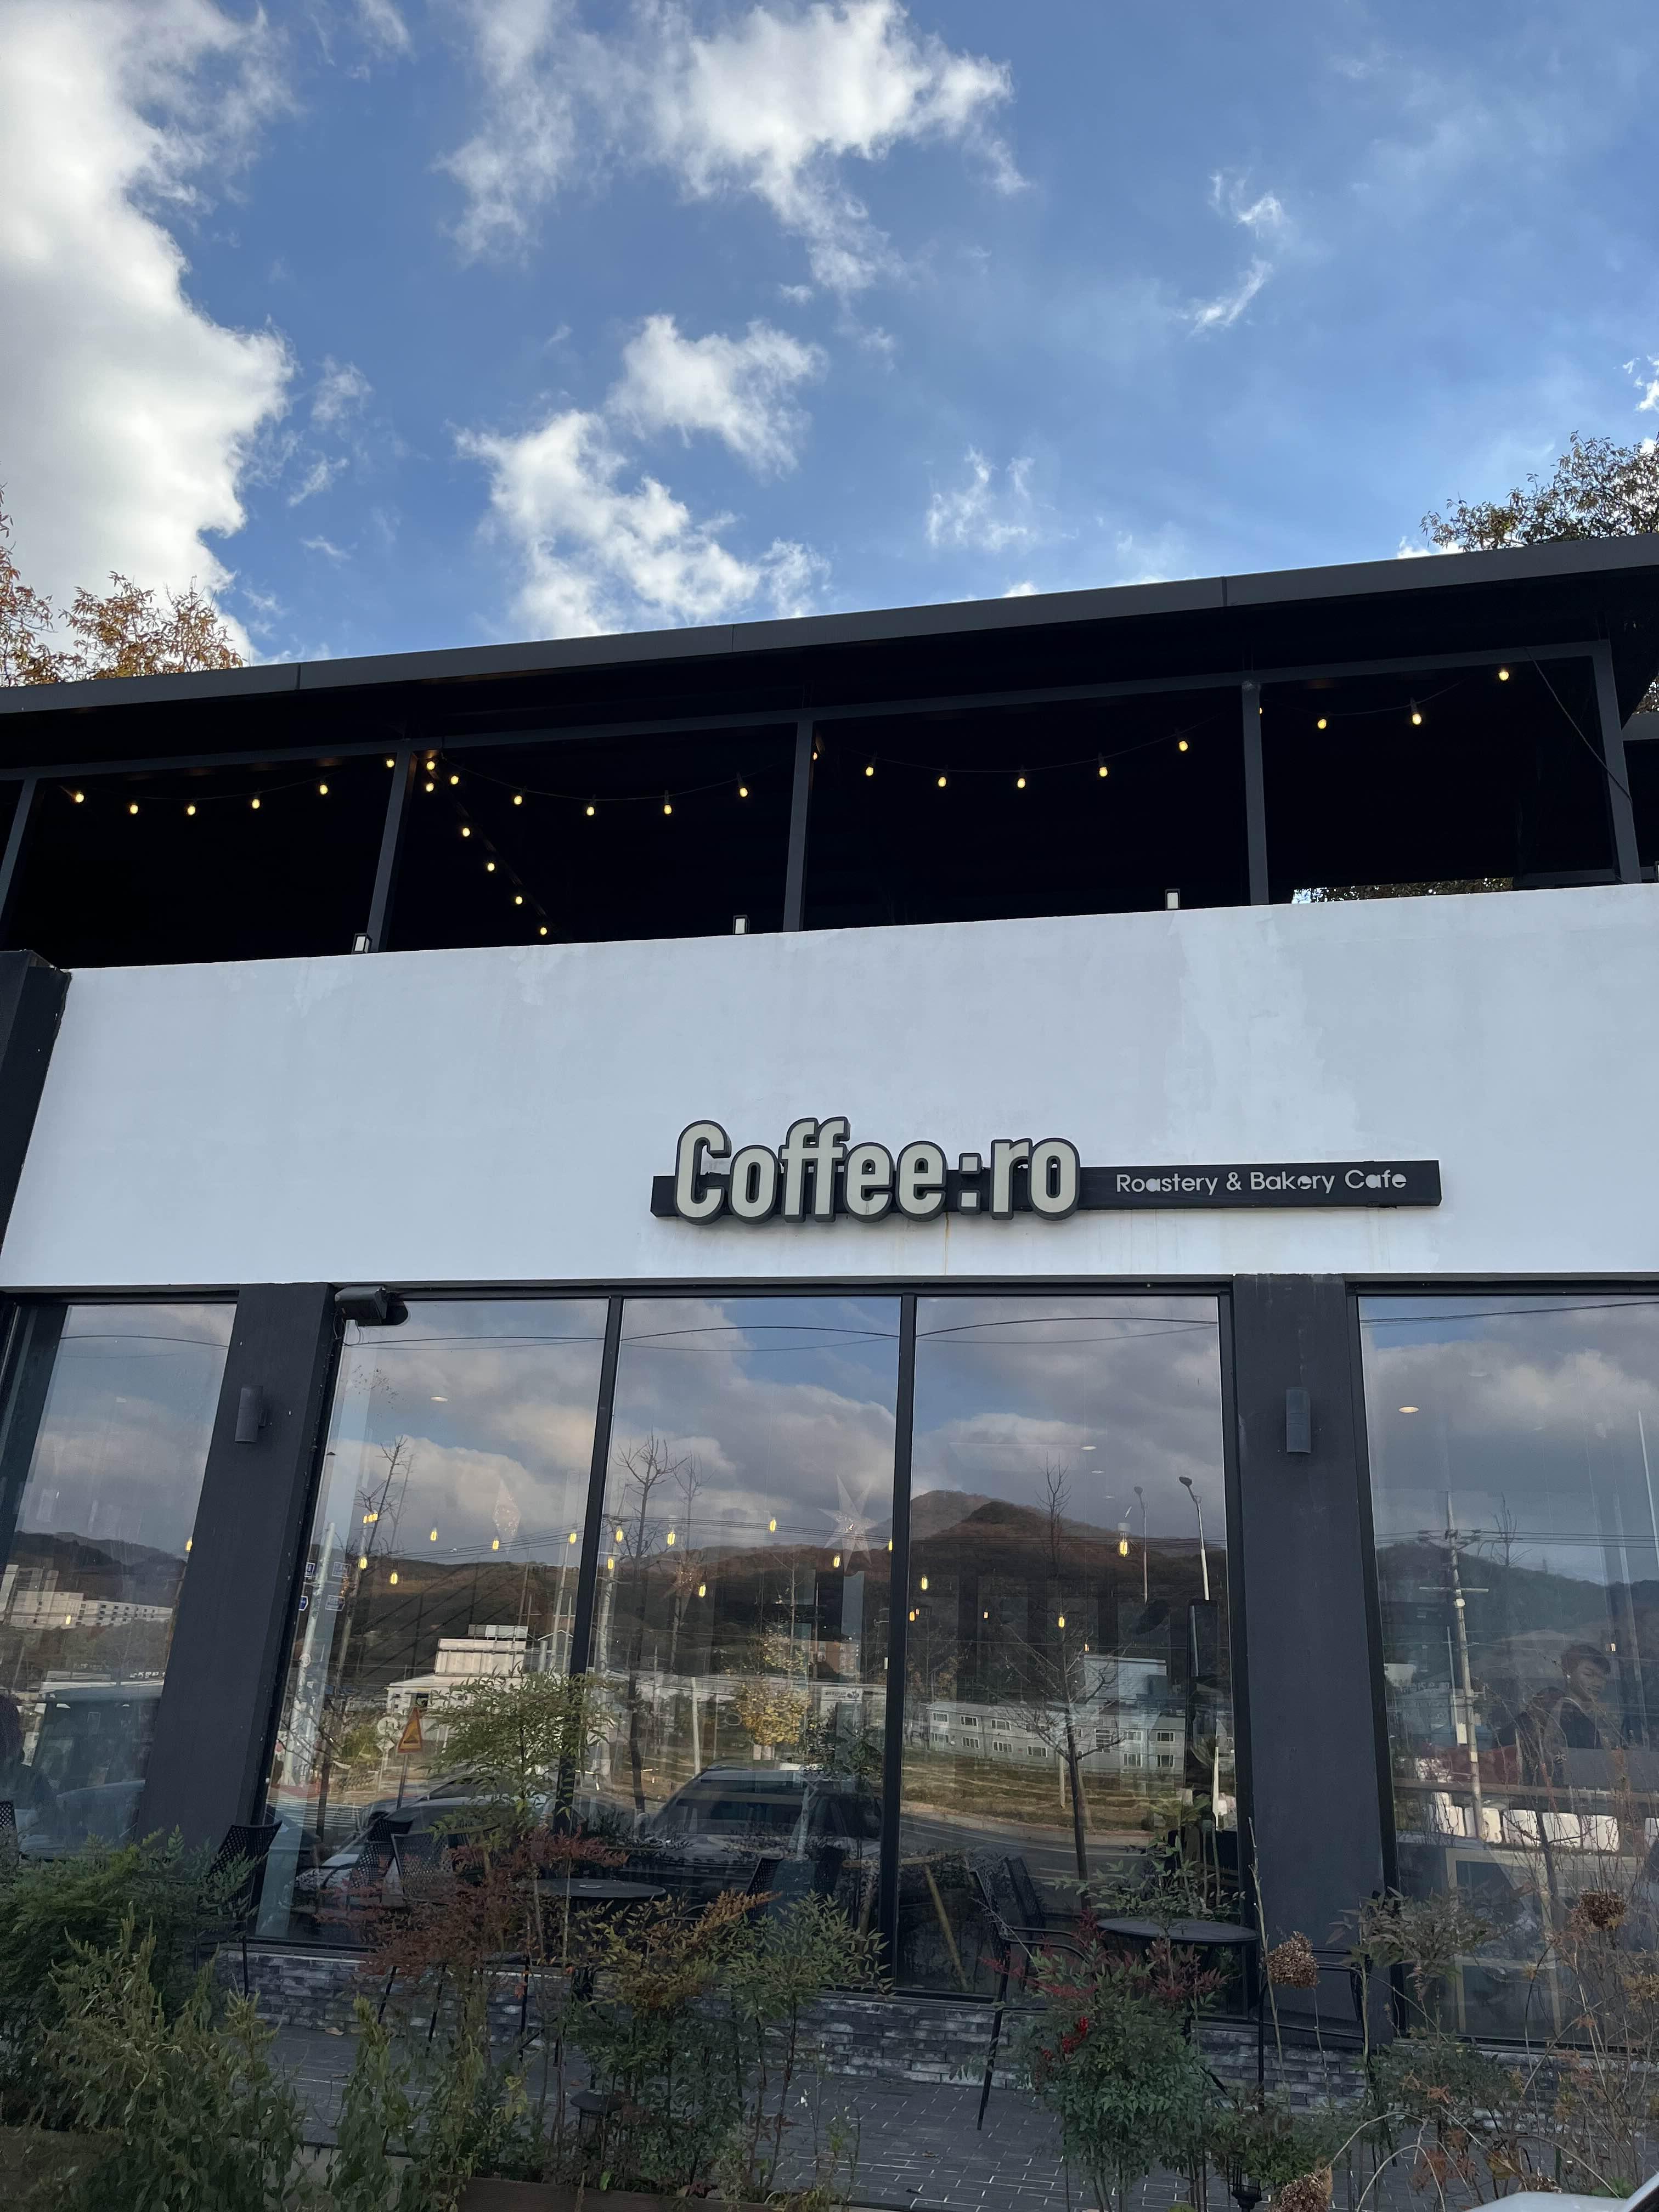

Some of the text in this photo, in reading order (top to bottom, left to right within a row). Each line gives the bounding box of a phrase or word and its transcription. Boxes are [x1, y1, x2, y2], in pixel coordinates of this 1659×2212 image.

[1116, 1169, 1408, 1195] Roastery & Bakery Cafe
